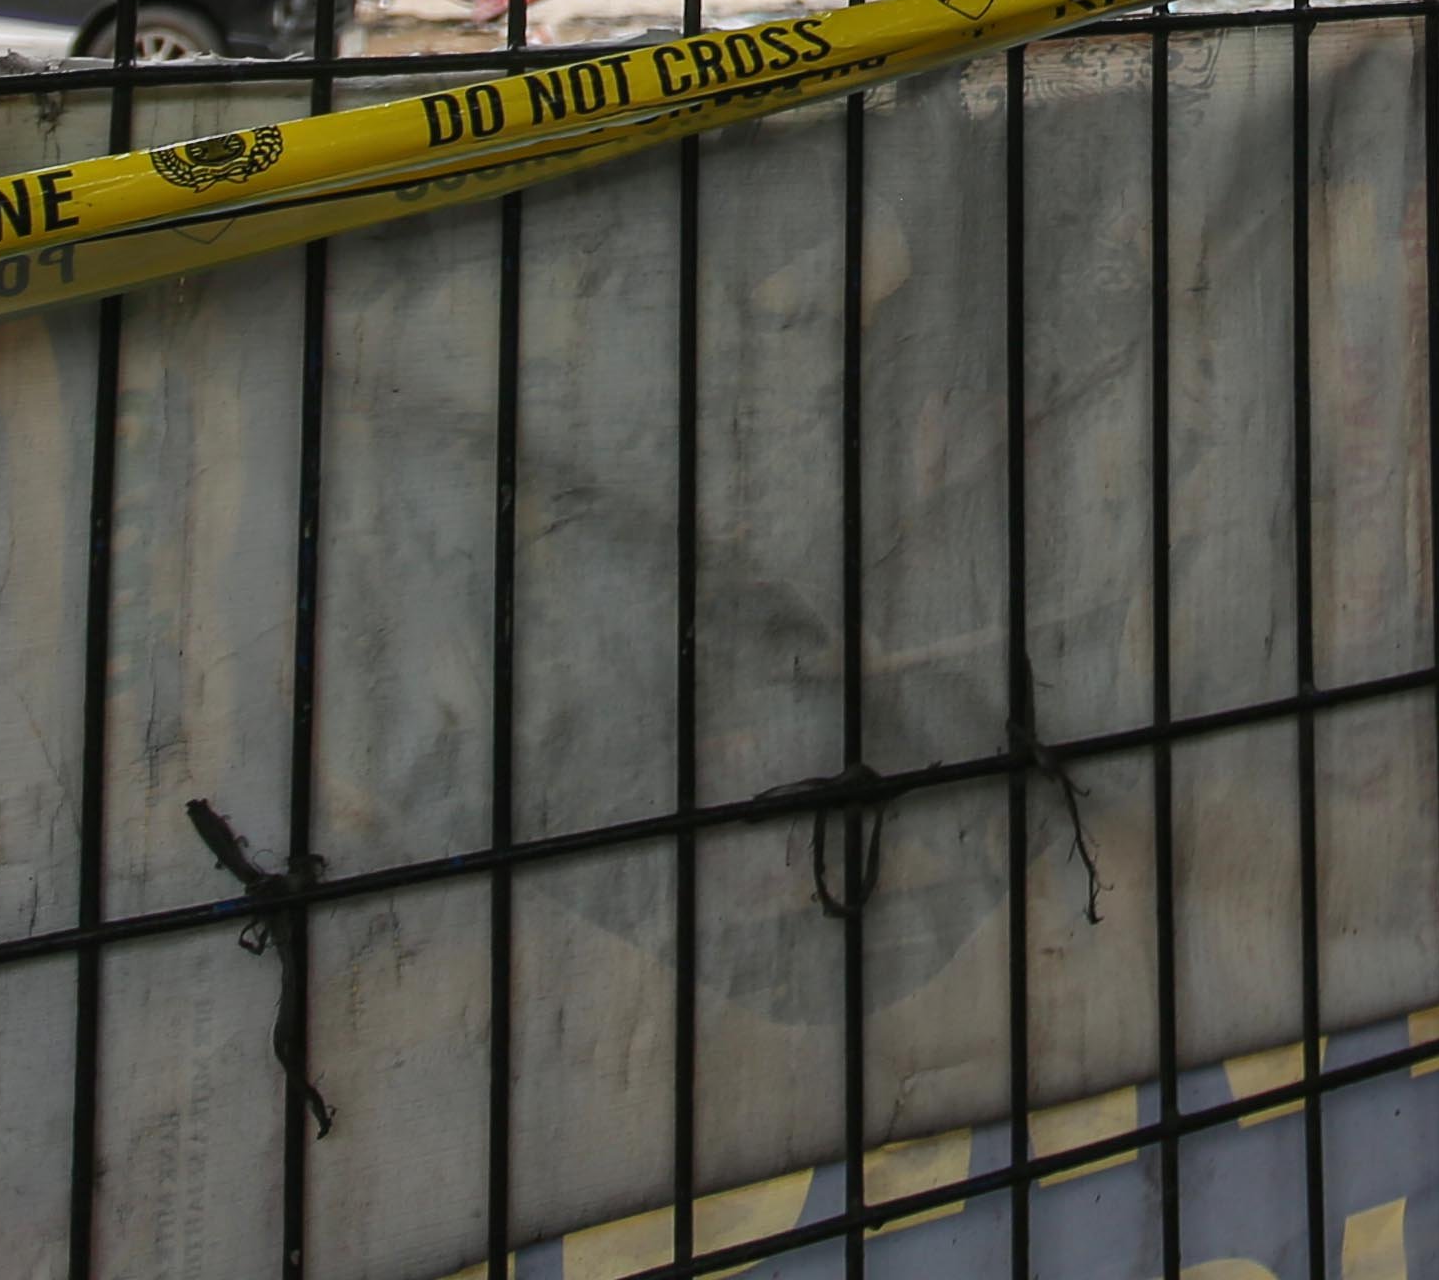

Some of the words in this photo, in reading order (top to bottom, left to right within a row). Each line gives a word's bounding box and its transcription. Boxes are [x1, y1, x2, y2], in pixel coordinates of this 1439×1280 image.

[420, 88, 505, 148] DO
[524, 52, 633, 126] NOT
[652, 18, 833, 97] CROSS
